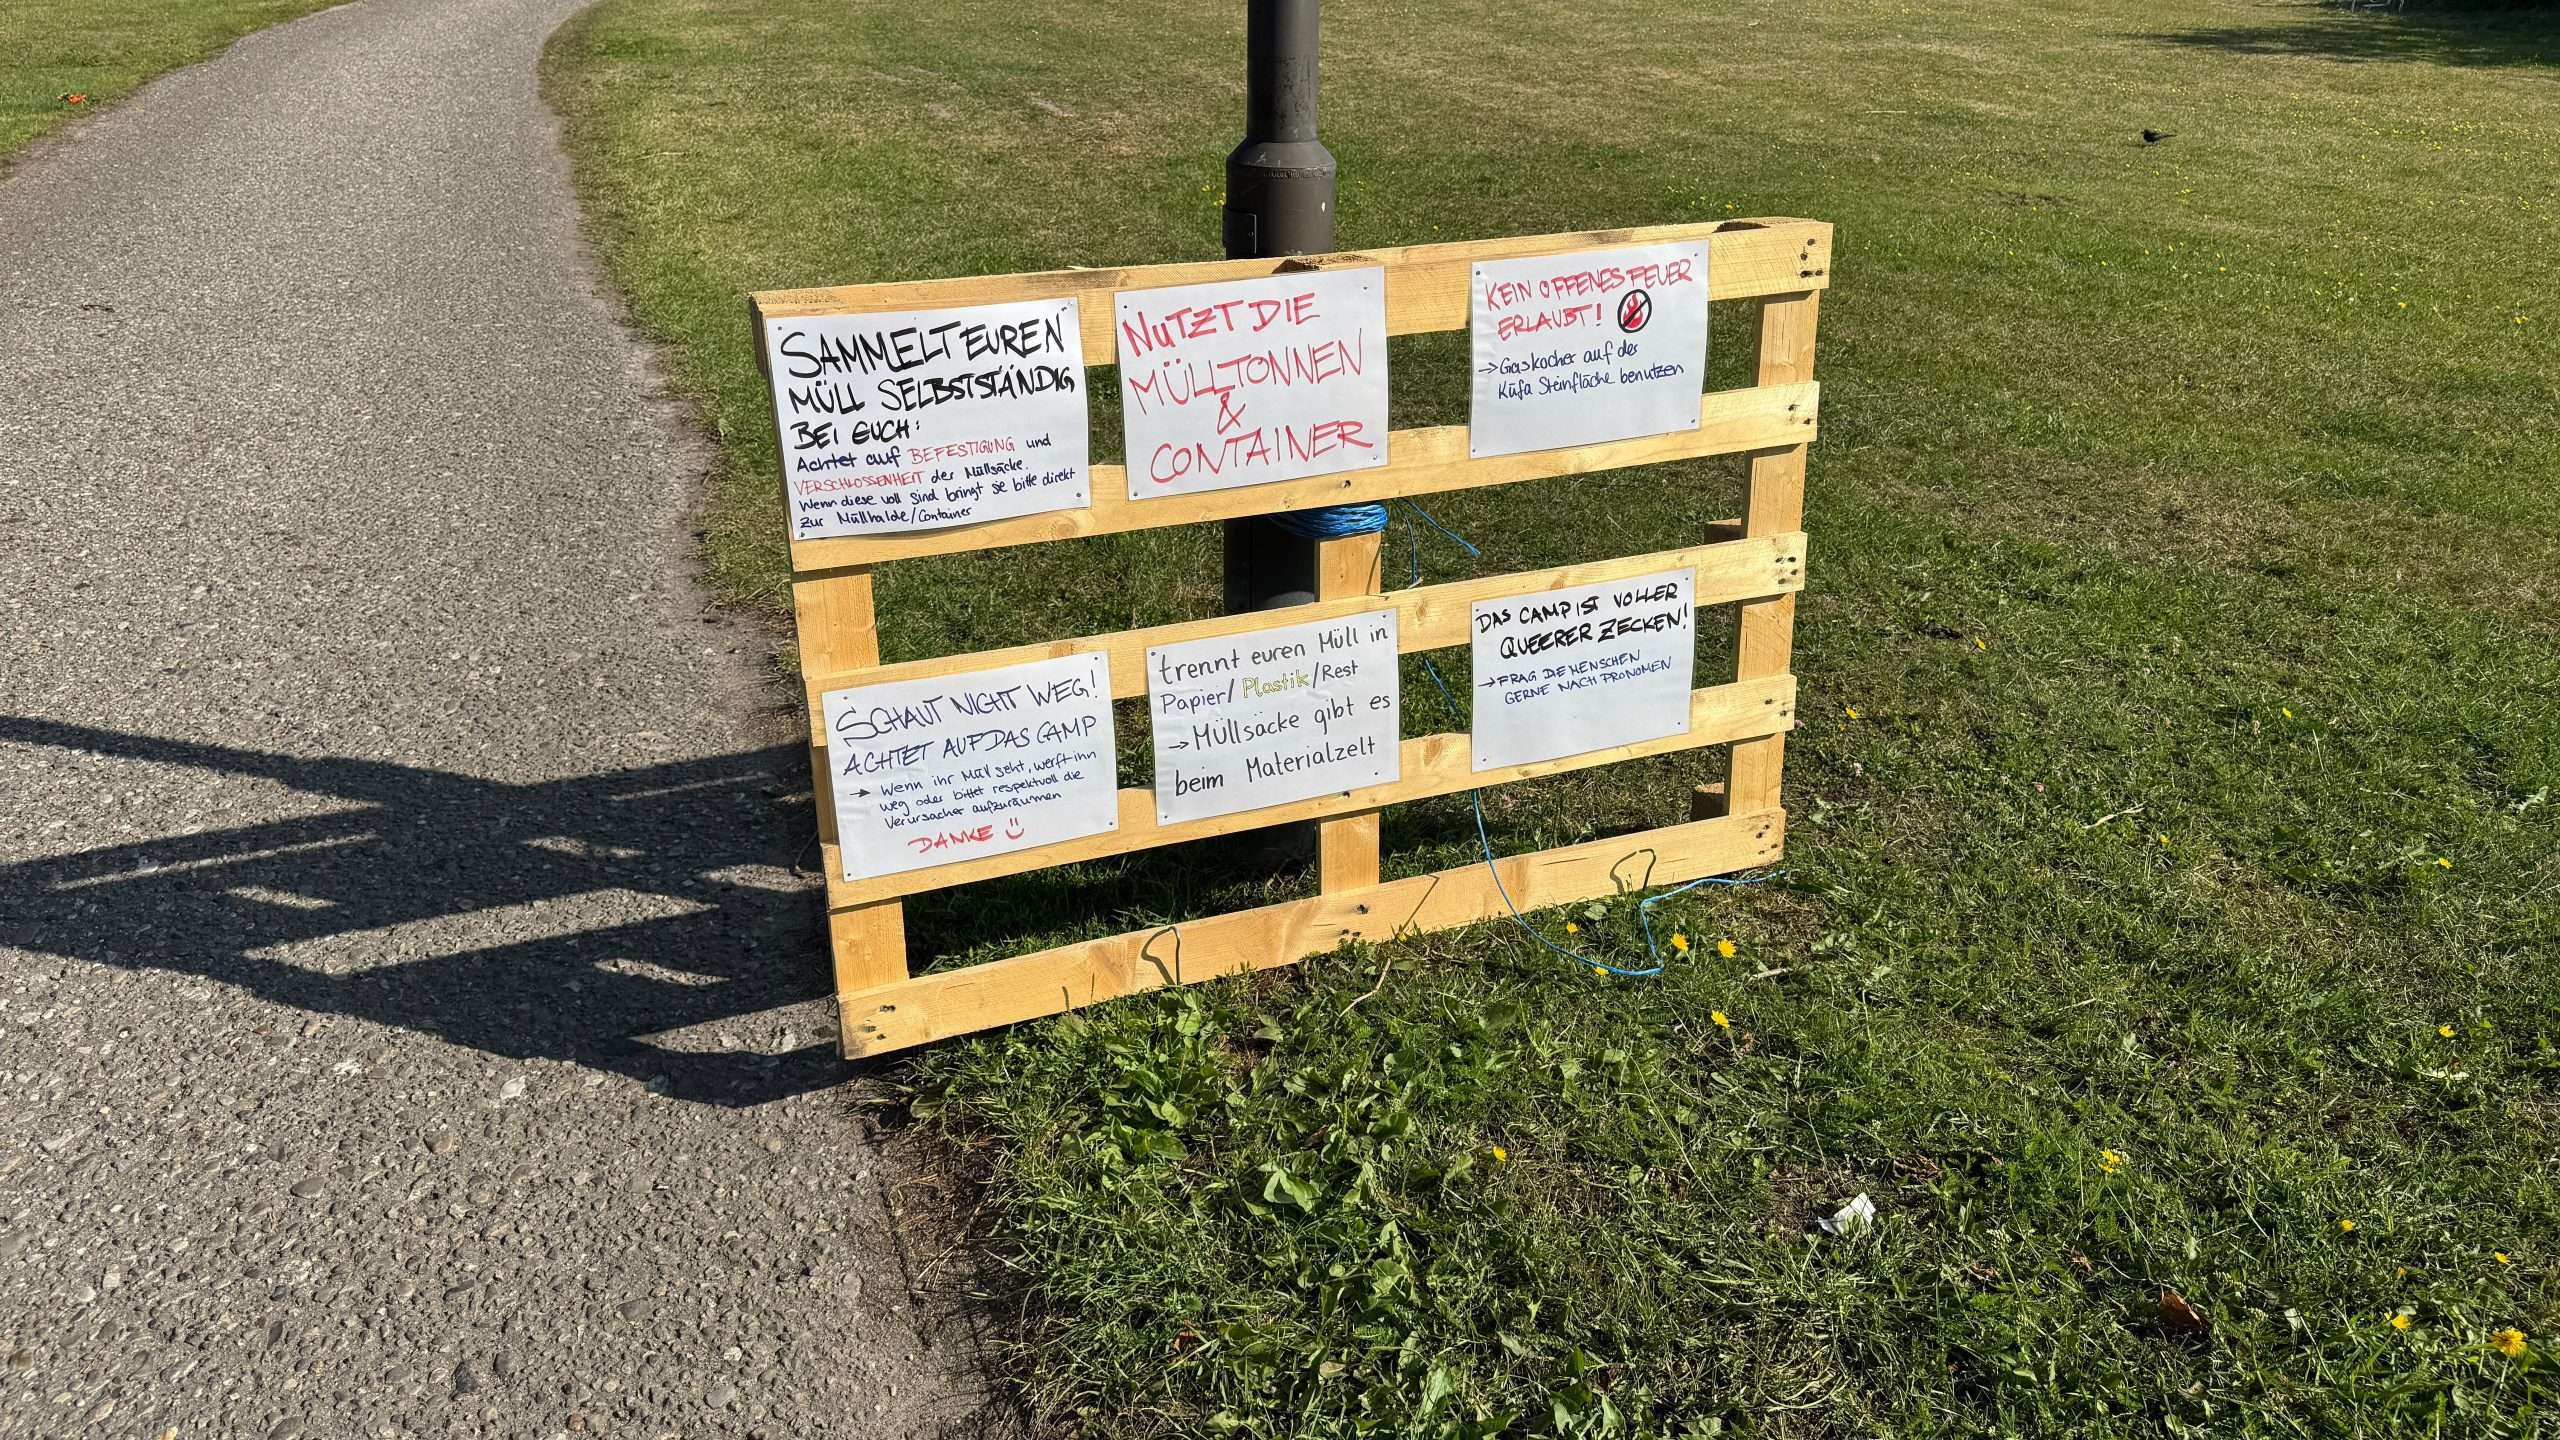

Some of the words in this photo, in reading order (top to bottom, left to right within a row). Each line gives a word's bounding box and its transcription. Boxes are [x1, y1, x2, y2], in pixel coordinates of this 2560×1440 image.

[1485, 280, 1532, 311] KEIN
[1539, 267, 1626, 300] OFFENES
[1626, 258, 1693, 290] FEUER
[780, 321, 961, 379] SAMMELT
[960, 313, 1064, 361] EUREN
[1122, 300, 1244, 357] NUTZT
[1248, 292, 1320, 332] DIE
[1129, 328, 1362, 415] MÜLLTONNEN
[1499, 349, 1576, 374] Gaskocher
[1583, 341, 1611, 364] auf
[1618, 340, 1639, 357] der
[1499, 381, 1533, 400] Küfa
[1539, 372, 1615, 396] Steinfläche
[1620, 363, 1684, 384] benutzen
[789, 380, 865, 414] MÜLL
[878, 364, 1075, 412] SELBSTSTÄNDIG
[1217, 391, 1246, 436] &
[790, 421, 839, 450] BEI
[852, 418, 920, 444] EUCH:
[797, 455, 858, 472] Achtet
[866, 446, 901, 467] auf
[907, 437, 1016, 464] BEFESTIGUNG
[1026, 433, 1051, 449] und
[1151, 420, 1374, 484] CONTAINER
[795, 471, 925, 495] VERSCHLOSSENHEIT
[931, 469, 954, 484] der
[799, 496, 837, 512] Wenn
[841, 494, 877, 507] diese
[882, 490, 902, 504] voll
[945, 483, 984, 502] bringt
[1014, 474, 1037, 493] bitte
[1042, 468, 1076, 485] direkt
[1476, 609, 1511, 634] DAS
[1519, 601, 1571, 624] CAMP
[1576, 595, 1600, 617] IST
[1614, 582, 1678, 608] VOLLER
[1500, 623, 1593, 659] QUEERER
[1598, 603, 1688, 643] ZECKEN!
[1159, 648, 1241, 685] trennt
[1251, 643, 1306, 665] euren
[1318, 626, 1358, 653] Müll
[1370, 625, 1388, 643] in
[1497, 671, 1537, 686] FRAG
[1569, 649, 1640, 676] MENSCHEN
[1504, 684, 1550, 705] GERNE
[1558, 676, 1597, 692] NACH
[1600, 656, 1671, 684] PRONOMEN
[836, 696, 943, 746] SCHAUT
[950, 686, 1021, 716] NICHT
[1026, 670, 1098, 707] WEG!
[1193, 711, 1299, 750] Müllsäcke
[1314, 696, 1354, 735] gibt
[1369, 694, 1390, 710] es
[843, 741, 934, 776] ACHTET
[942, 733, 984, 758] AUF
[983, 728, 1030, 751] DAS
[1036, 716, 1096, 744] CAMP
[1175, 766, 1224, 796] beim
[1246, 735, 1375, 783] Materialzelt
[880, 782, 922, 796] Wenn
[932, 773, 955, 787] ihr
[1032, 757, 1072, 772] werft
[1072, 751, 1096, 764] ihn
[916, 795, 943, 807] oder
[952, 786, 984, 800] bittet
[992, 774, 1058, 794] respektvoll
[1064, 770, 1084, 780] die
[884, 806, 964, 830] Verursacher
[972, 792, 1061, 814] aufzuräumen
[907, 824, 994, 854] DANKE
